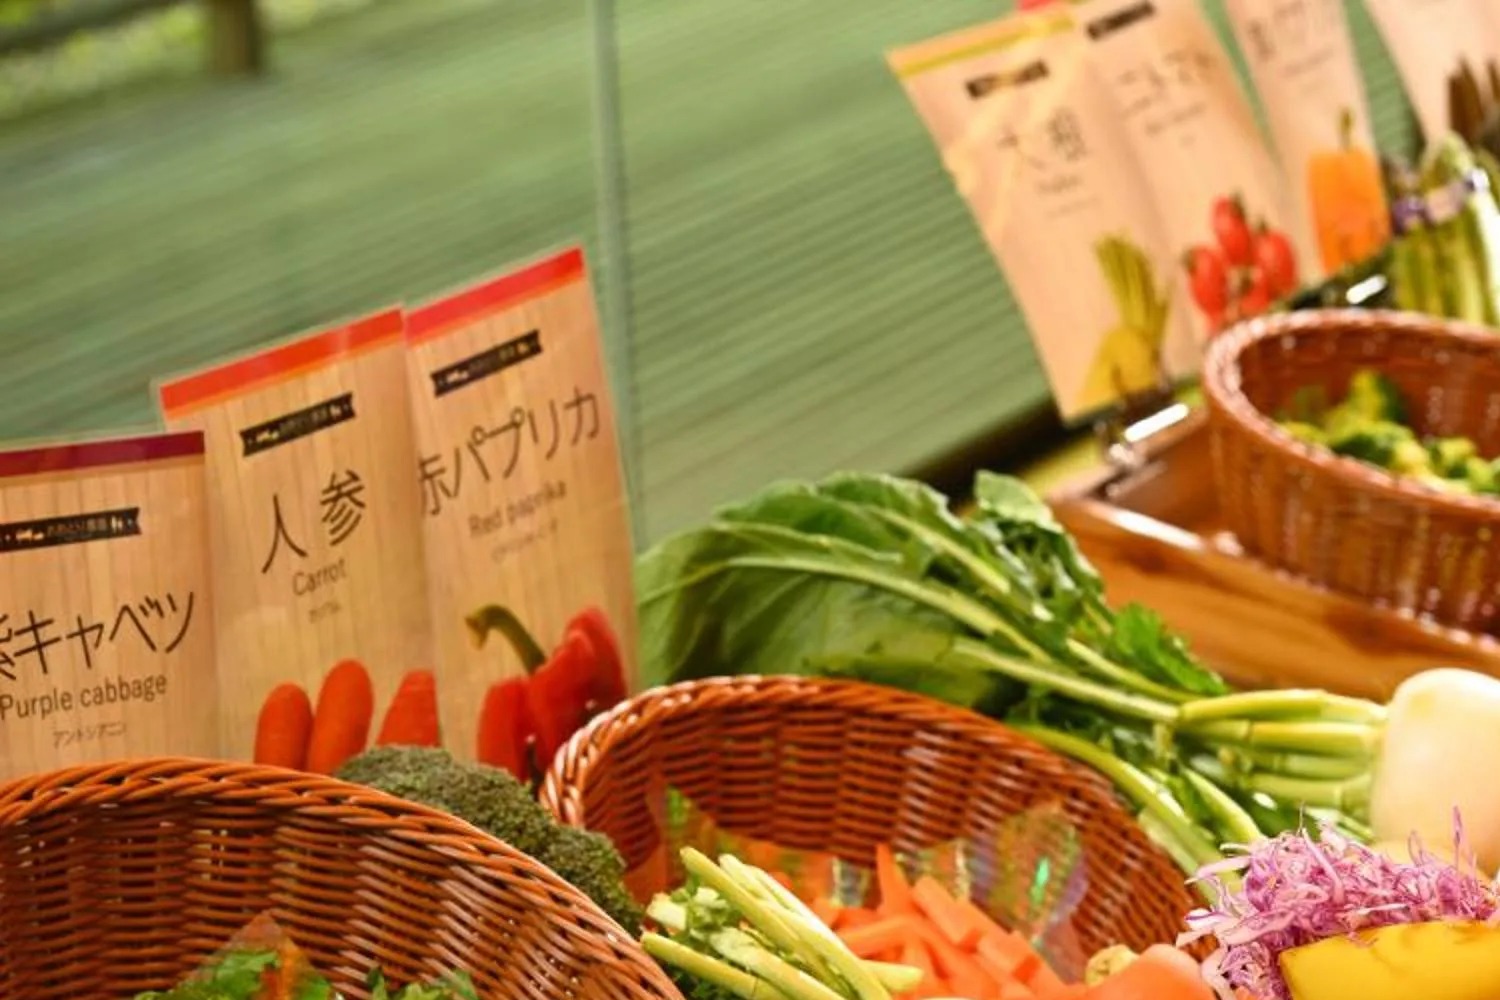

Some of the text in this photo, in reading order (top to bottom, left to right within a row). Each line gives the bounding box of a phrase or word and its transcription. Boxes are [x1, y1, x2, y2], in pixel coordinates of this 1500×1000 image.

[261, 469, 366, 574] 人参
[468, 507, 503, 538] Red
[292, 557, 347, 597] Carrot
[0, 674, 168, 720] Purple cabbage
